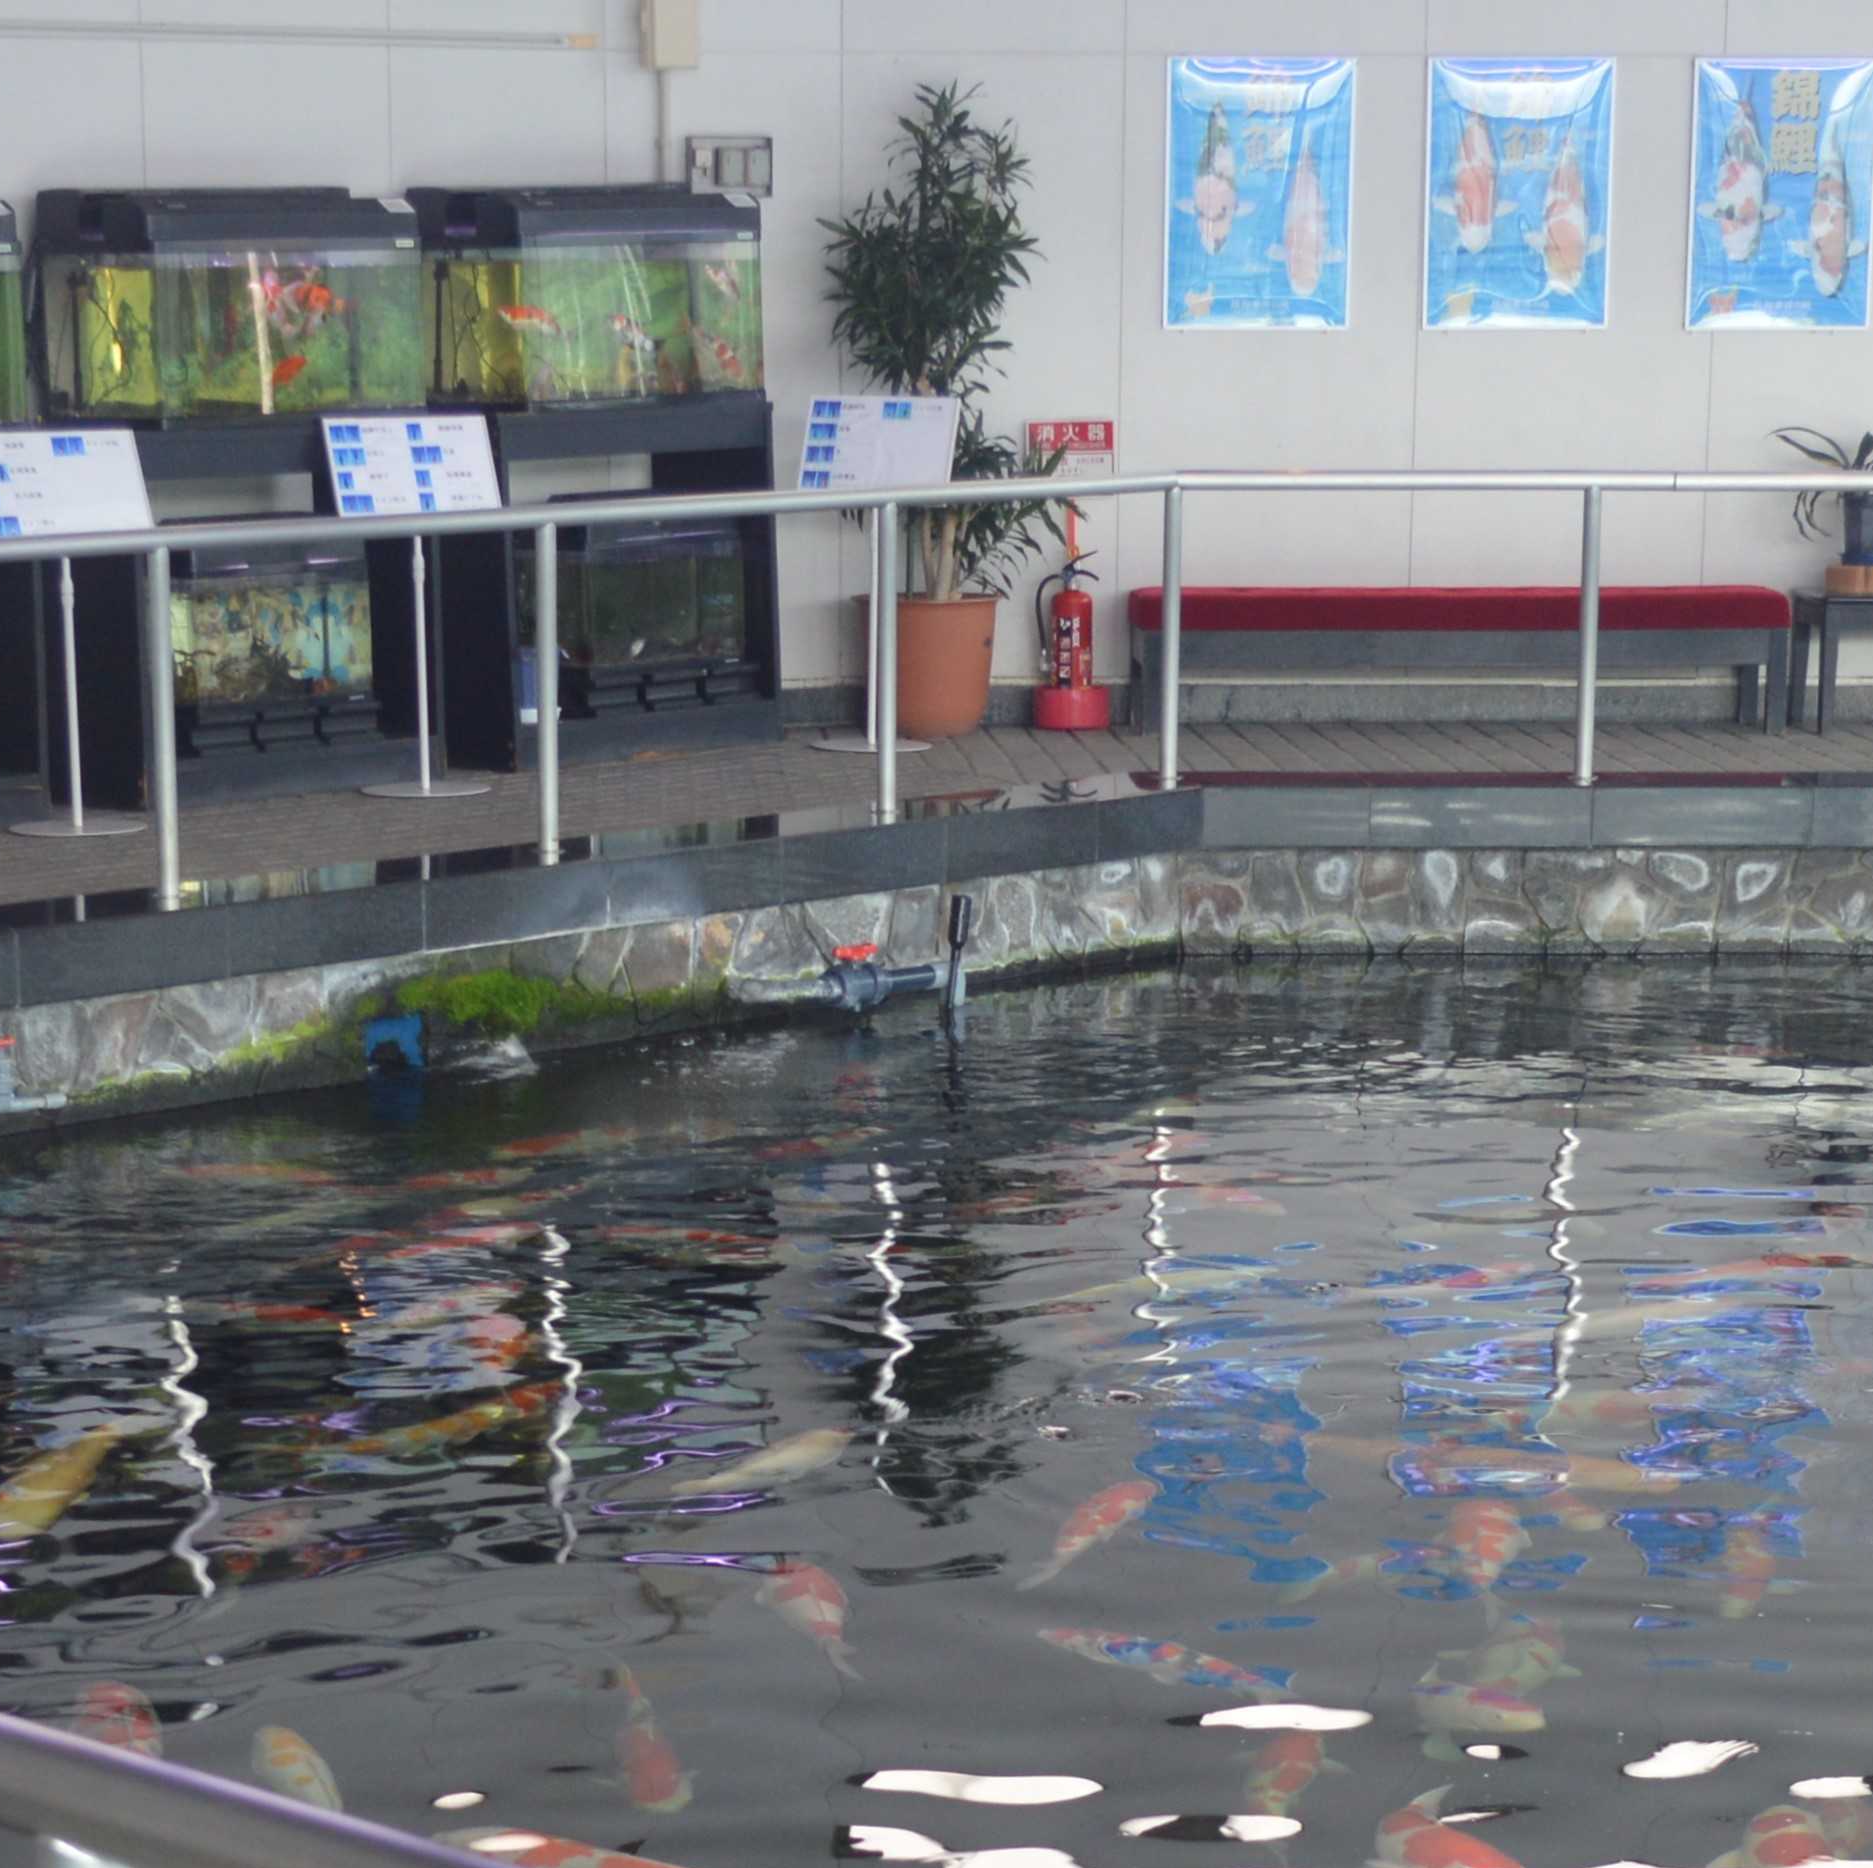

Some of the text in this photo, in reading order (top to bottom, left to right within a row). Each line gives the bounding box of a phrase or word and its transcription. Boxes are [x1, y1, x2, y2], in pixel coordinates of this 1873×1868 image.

[1770, 70, 1821, 175] 錦鯉
[1036, 423, 1105, 441] 消火器
